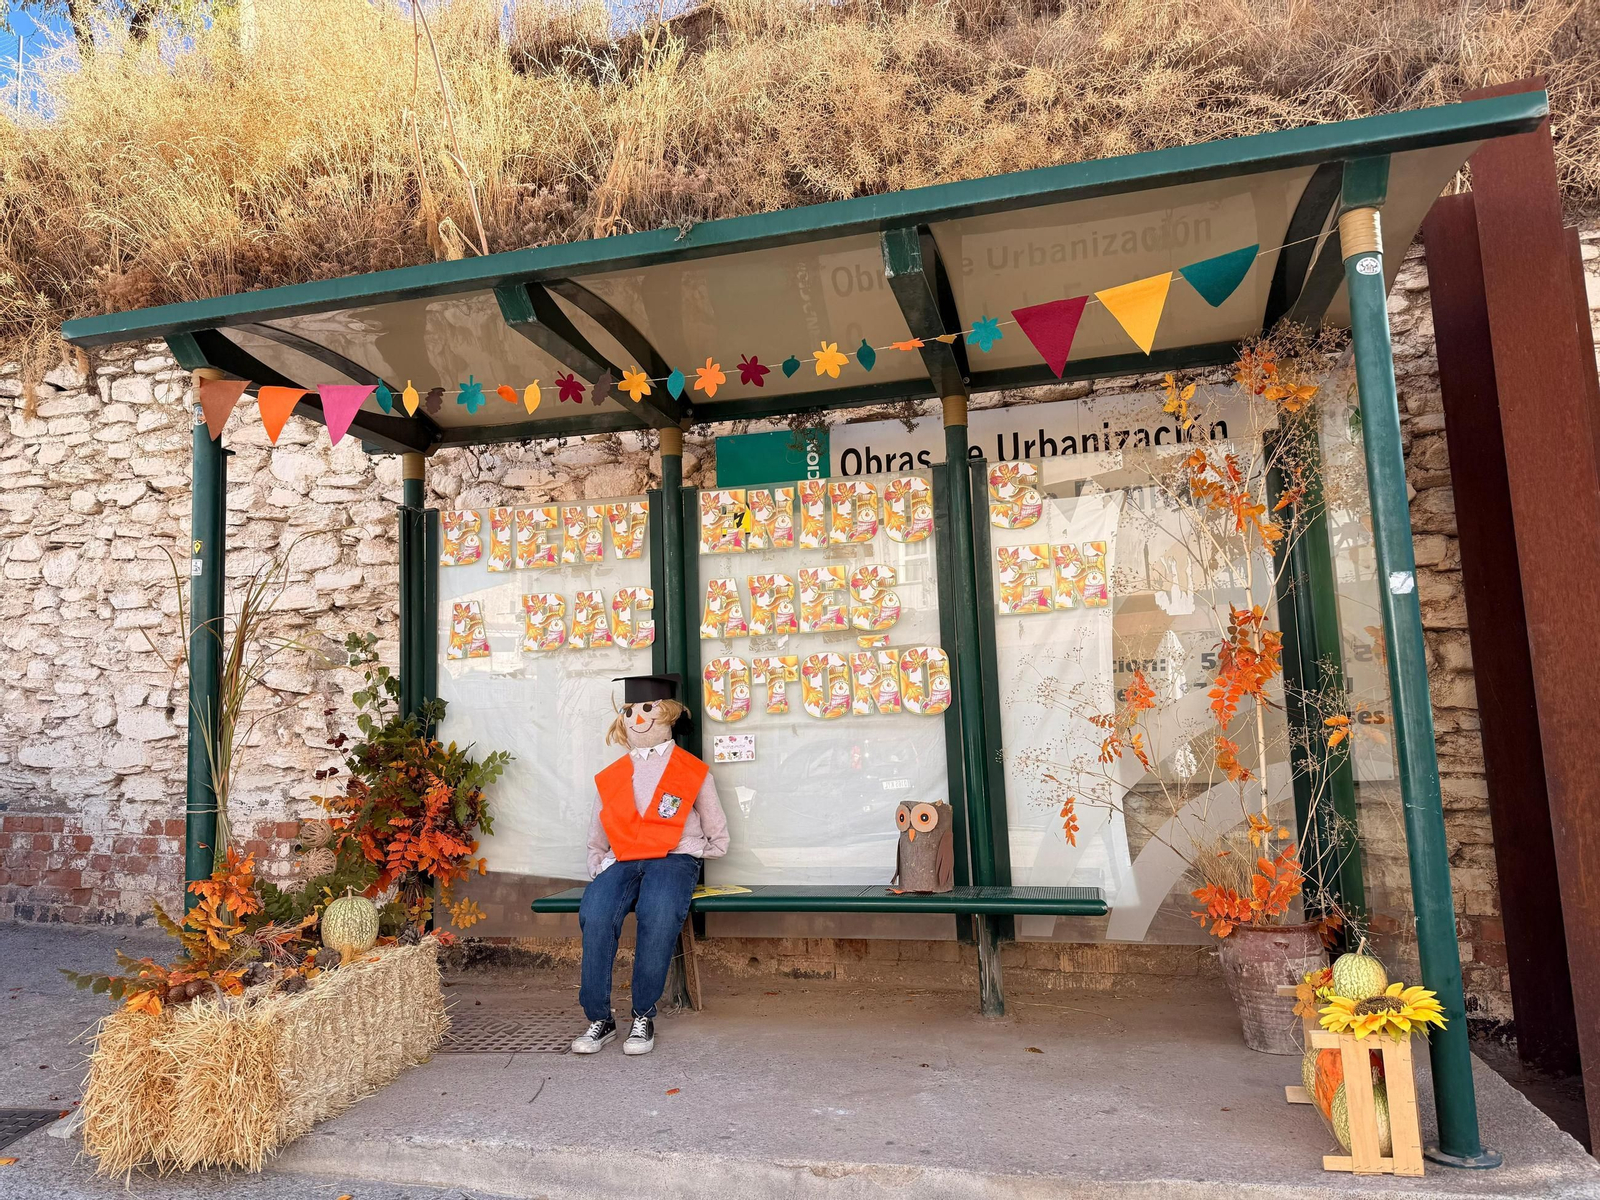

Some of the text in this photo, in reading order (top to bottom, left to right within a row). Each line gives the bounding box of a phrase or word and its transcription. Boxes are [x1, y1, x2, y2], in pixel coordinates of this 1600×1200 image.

[840, 414, 1228, 476] Obras e Urbanización
[447, 601, 490, 660] A
[996, 541, 1109, 615] EN
[703, 634, 952, 722] OTOÑO
